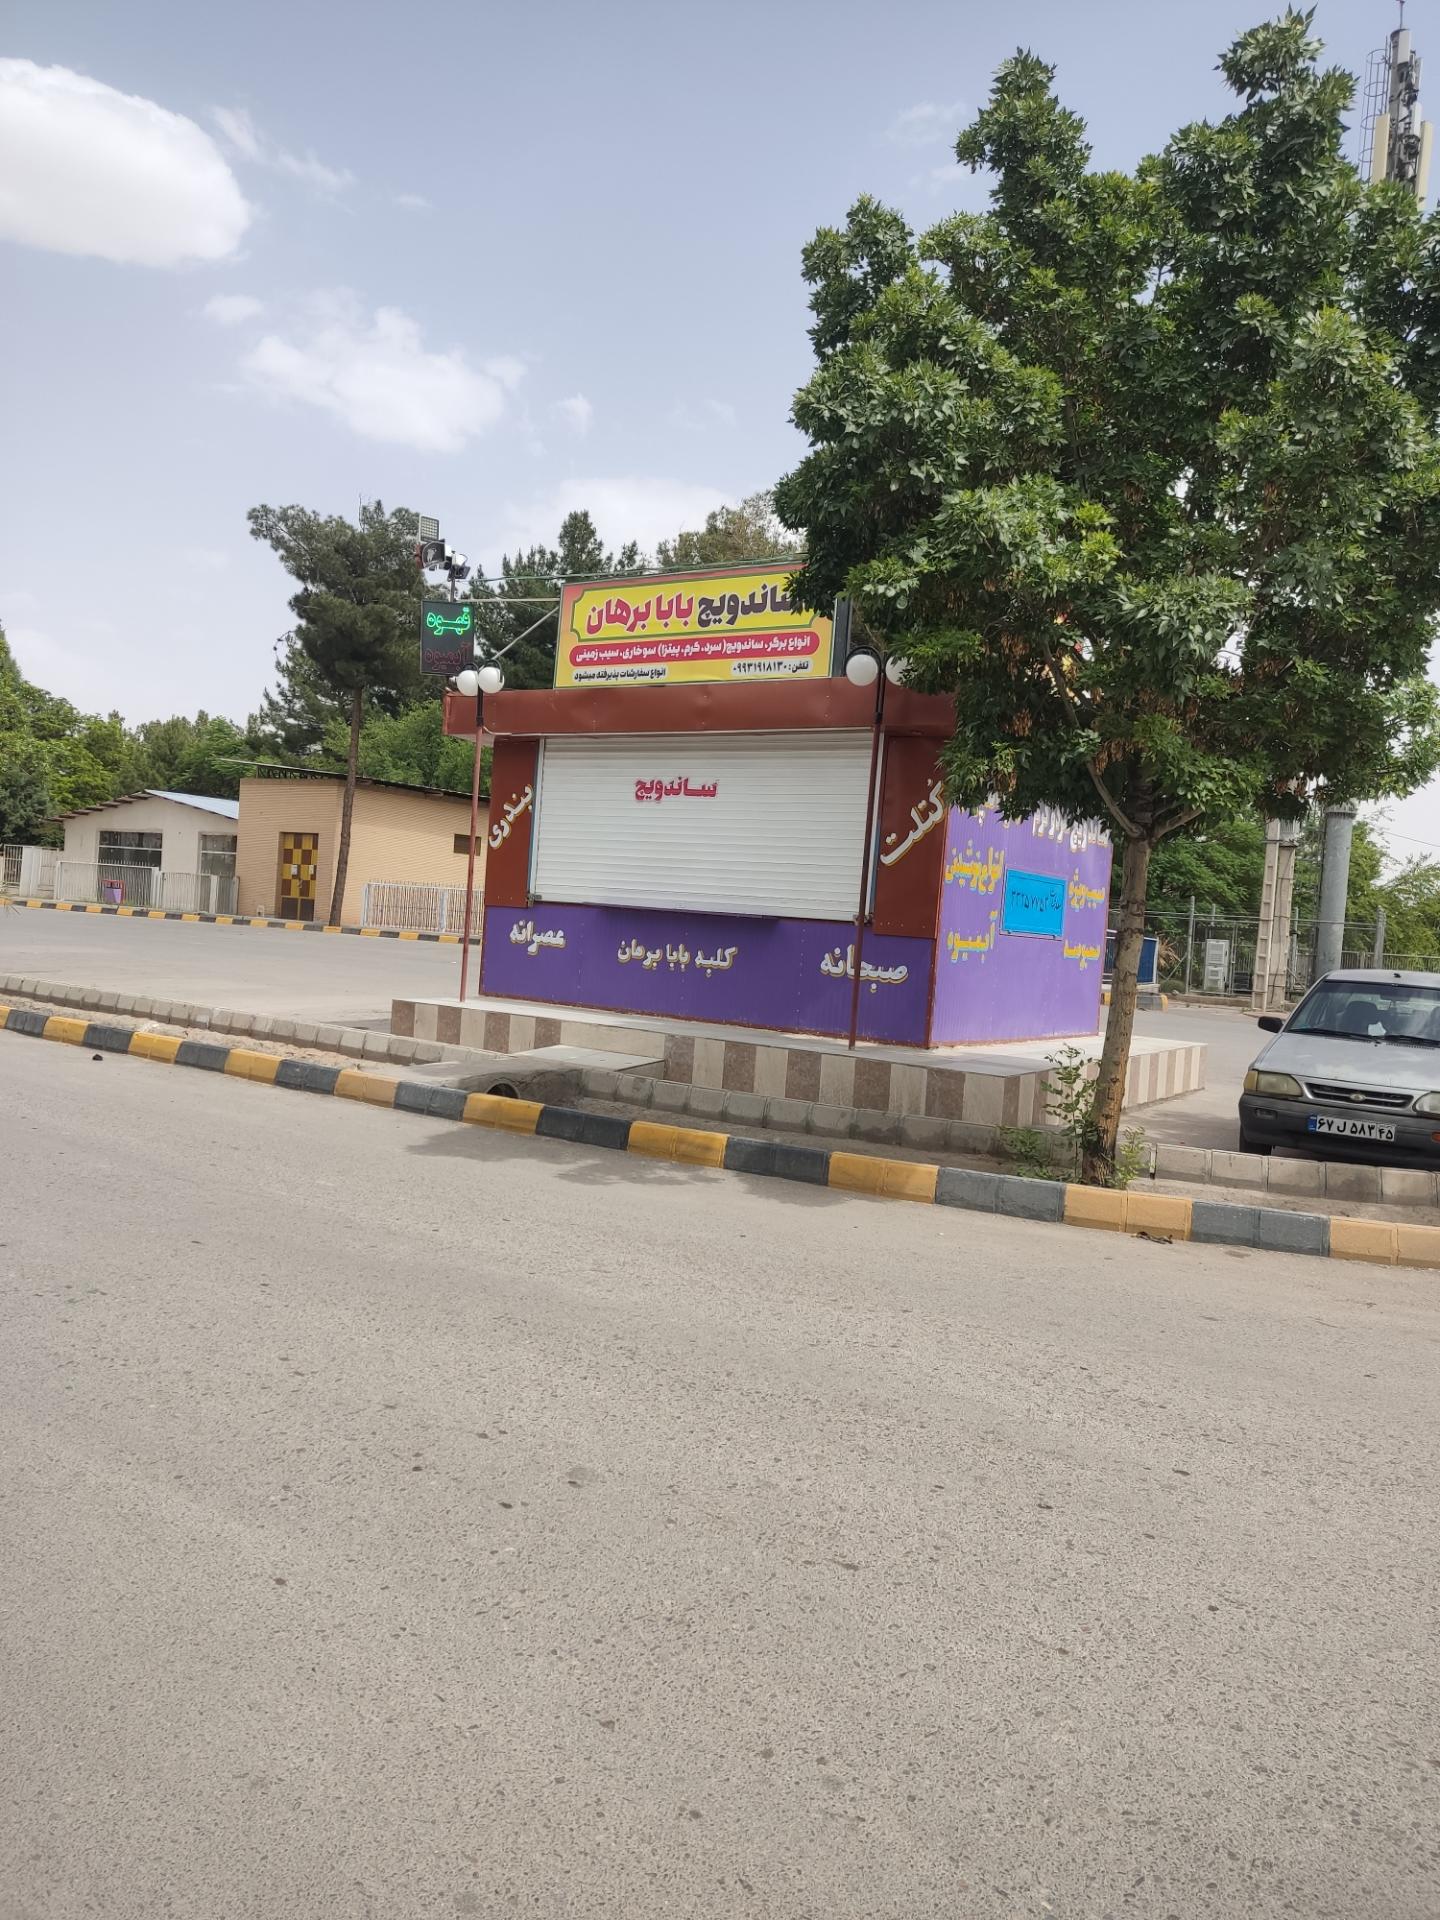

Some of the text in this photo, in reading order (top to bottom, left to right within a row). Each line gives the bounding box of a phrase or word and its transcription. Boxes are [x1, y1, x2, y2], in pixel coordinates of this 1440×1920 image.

[426, 606, 471, 636] قهوه
[587, 597, 651, 634] برهان
[656, 593, 693, 629] بابا
[575, 648, 598, 662] زمینی
[599, 648, 620, 661] سیب
[788, 635, 811, 651] انواع
[650, 667, 666, 680] انواع
[634, 776, 718, 801] ساندویچ
[489, 783, 534, 849] بندری
[509, 919, 567, 955] عصرانه
[616, 938, 739, 978] کلبه بابا برهان
[819, 943, 909, 993] صبحانه
[1317, 1118, 1394, 1140] ۶۷ ل ۵۸۳ ۴۵
